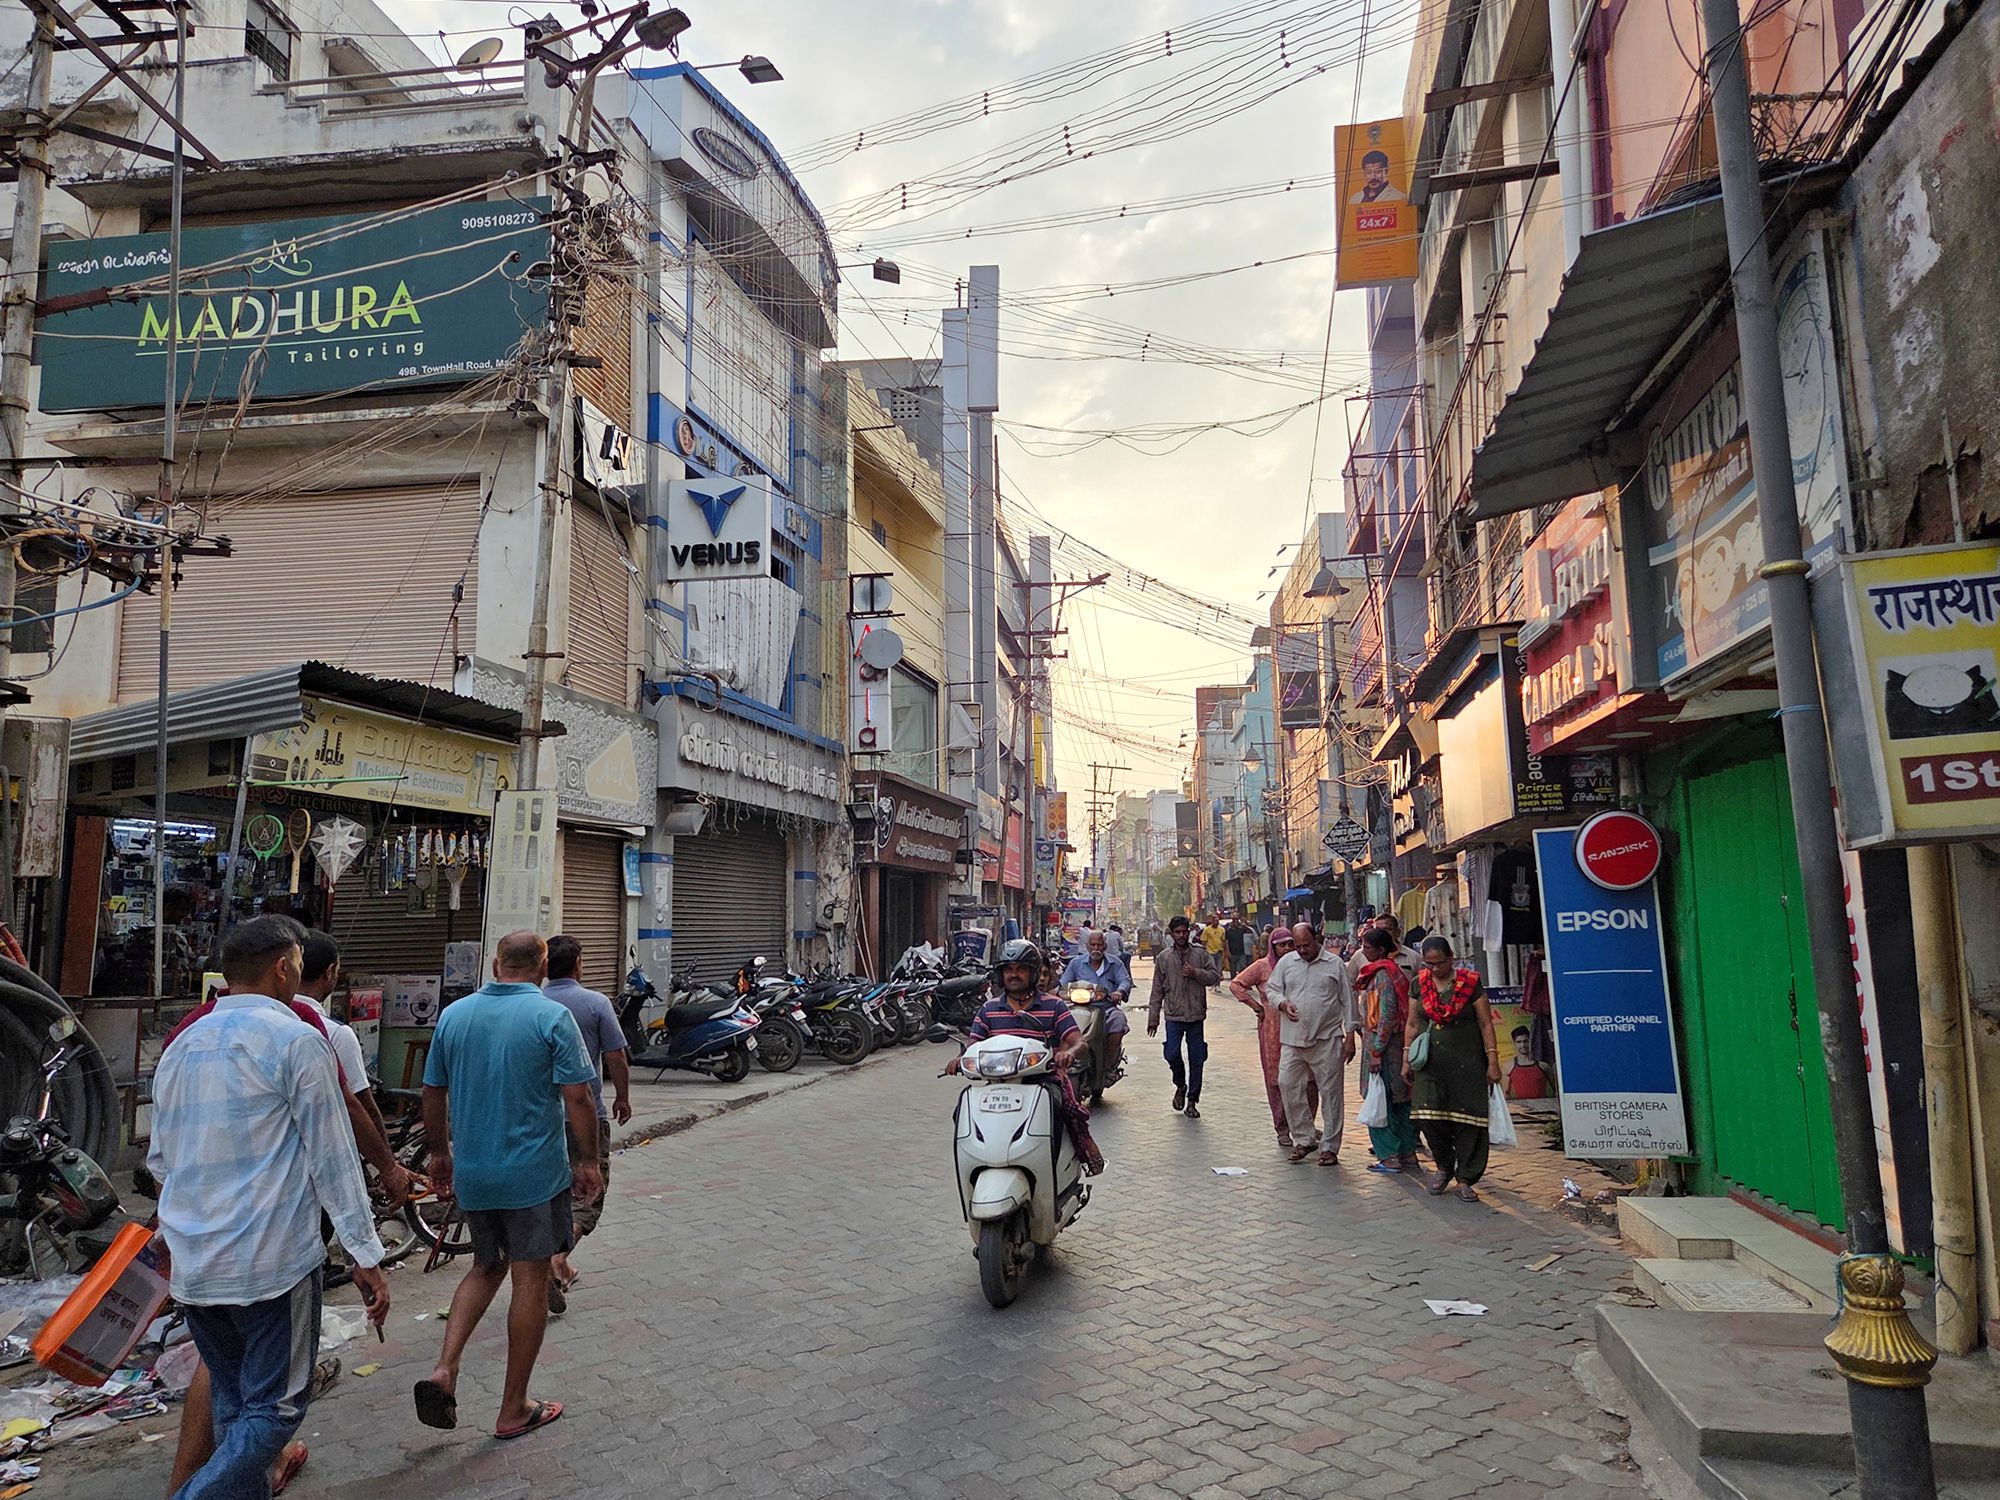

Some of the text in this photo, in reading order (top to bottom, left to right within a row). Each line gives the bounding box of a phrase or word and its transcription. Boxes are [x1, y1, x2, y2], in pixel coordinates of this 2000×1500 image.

[462, 212, 535, 229] 9095108273
[1360, 216, 1388, 229] 24x7
[138, 280, 422, 347] MADHURA
[288, 341, 424, 363] Tailoring
[398, 366, 419, 377] 49B,
[466, 360, 493, 371] Road,
[671, 541, 761, 568] VENUS
[1555, 526, 1609, 620] BRITI
[1522, 645, 1597, 726] CAMERA
[1593, 621, 1622, 681] ST
[355, 725, 474, 775] Emirates
[412, 773, 465, 795] Electronics
[1517, 783, 1561, 792] Prince
[1557, 908, 1648, 932] EPSON
[1563, 1015, 1662, 1025] CERTIFIED CHANNEL
[1590, 1023, 1636, 1032] PARTNER
[1574, 1101, 1668, 1111] BRITISH CAMERA
[1600, 1111, 1644, 1120] STORES
[1595, 1124, 1653, 1138] பிரிட்டிஷ்
[1569, 1138, 1683, 1151] கேமரா ஸ்டோர்ஸ்
